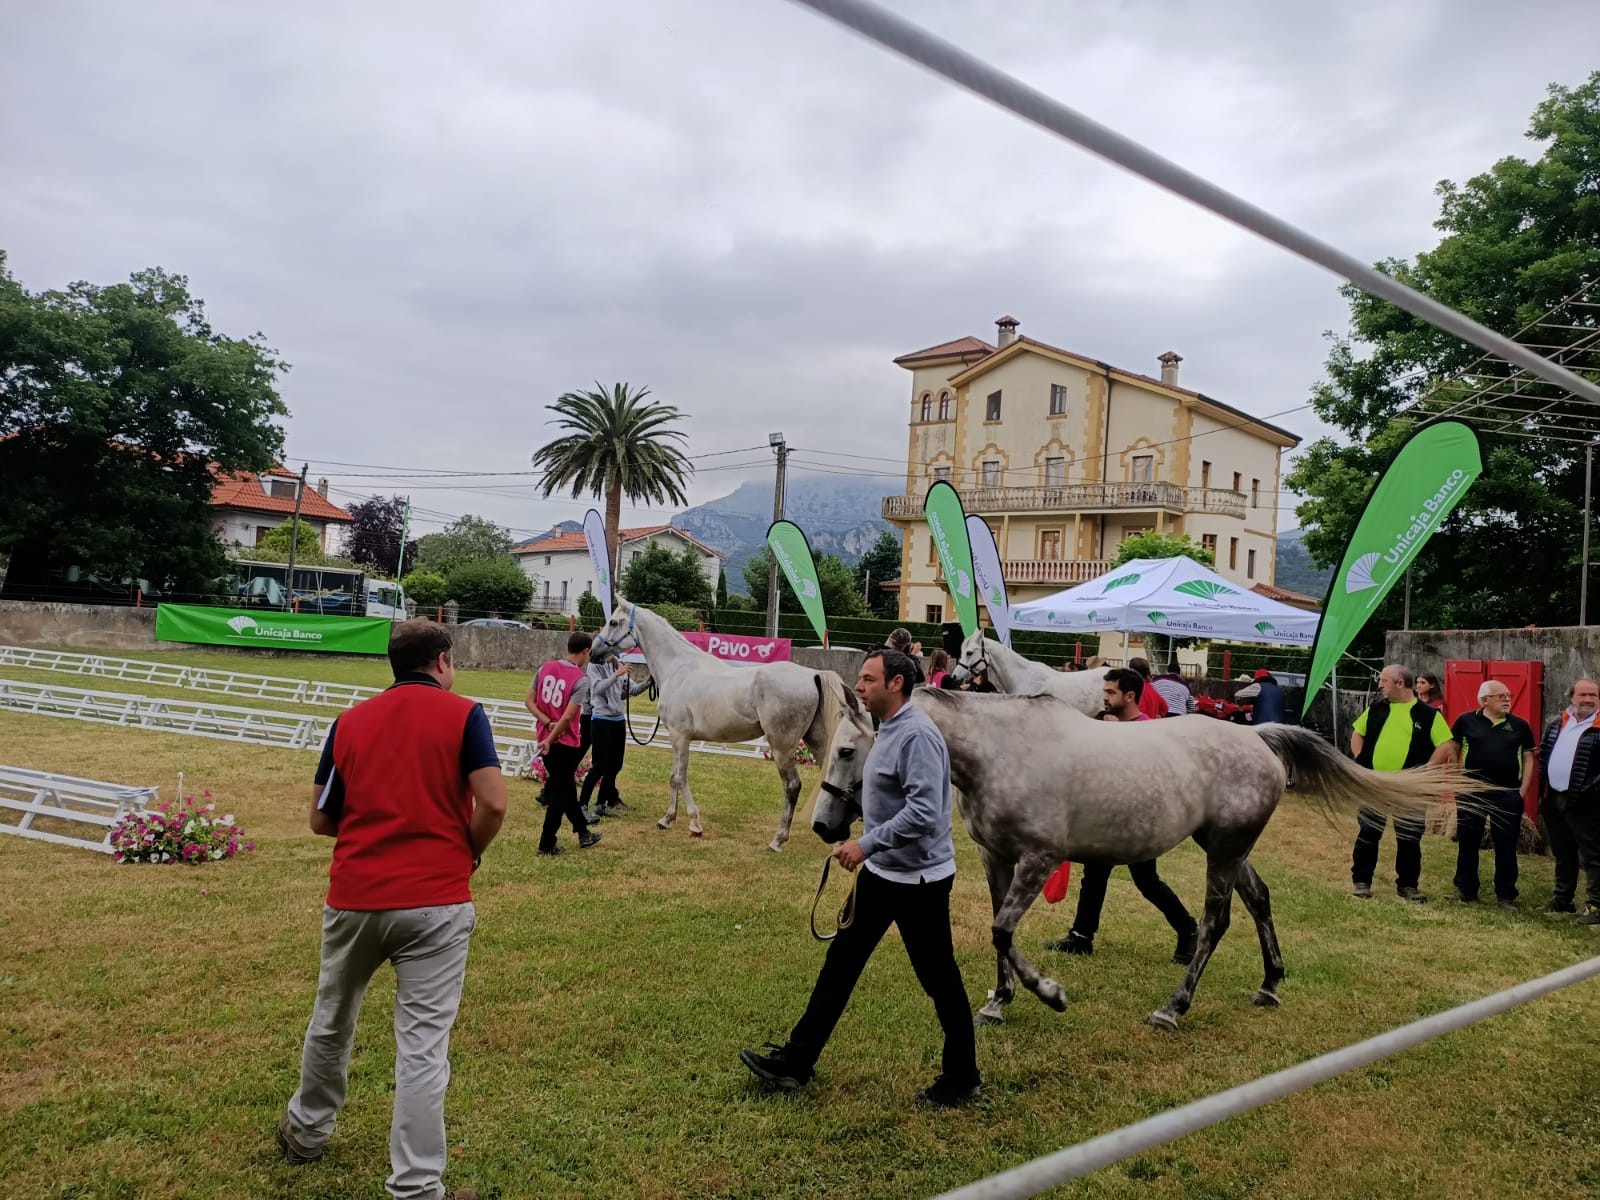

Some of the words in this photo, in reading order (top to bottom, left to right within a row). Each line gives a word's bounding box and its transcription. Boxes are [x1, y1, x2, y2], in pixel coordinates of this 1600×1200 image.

[1383, 511, 1431, 564] Unicaja
[1423, 469, 1463, 512] Banco
[255, 627, 291, 640] Unicaja
[292, 629, 322, 640] Banco
[1166, 620, 1192, 631] Unicaja
[1192, 622, 1213, 631] Banco
[1273, 630, 1299, 641] Unicaja
[707, 636, 750, 658] Pavo
[541, 674, 566, 708] 86
